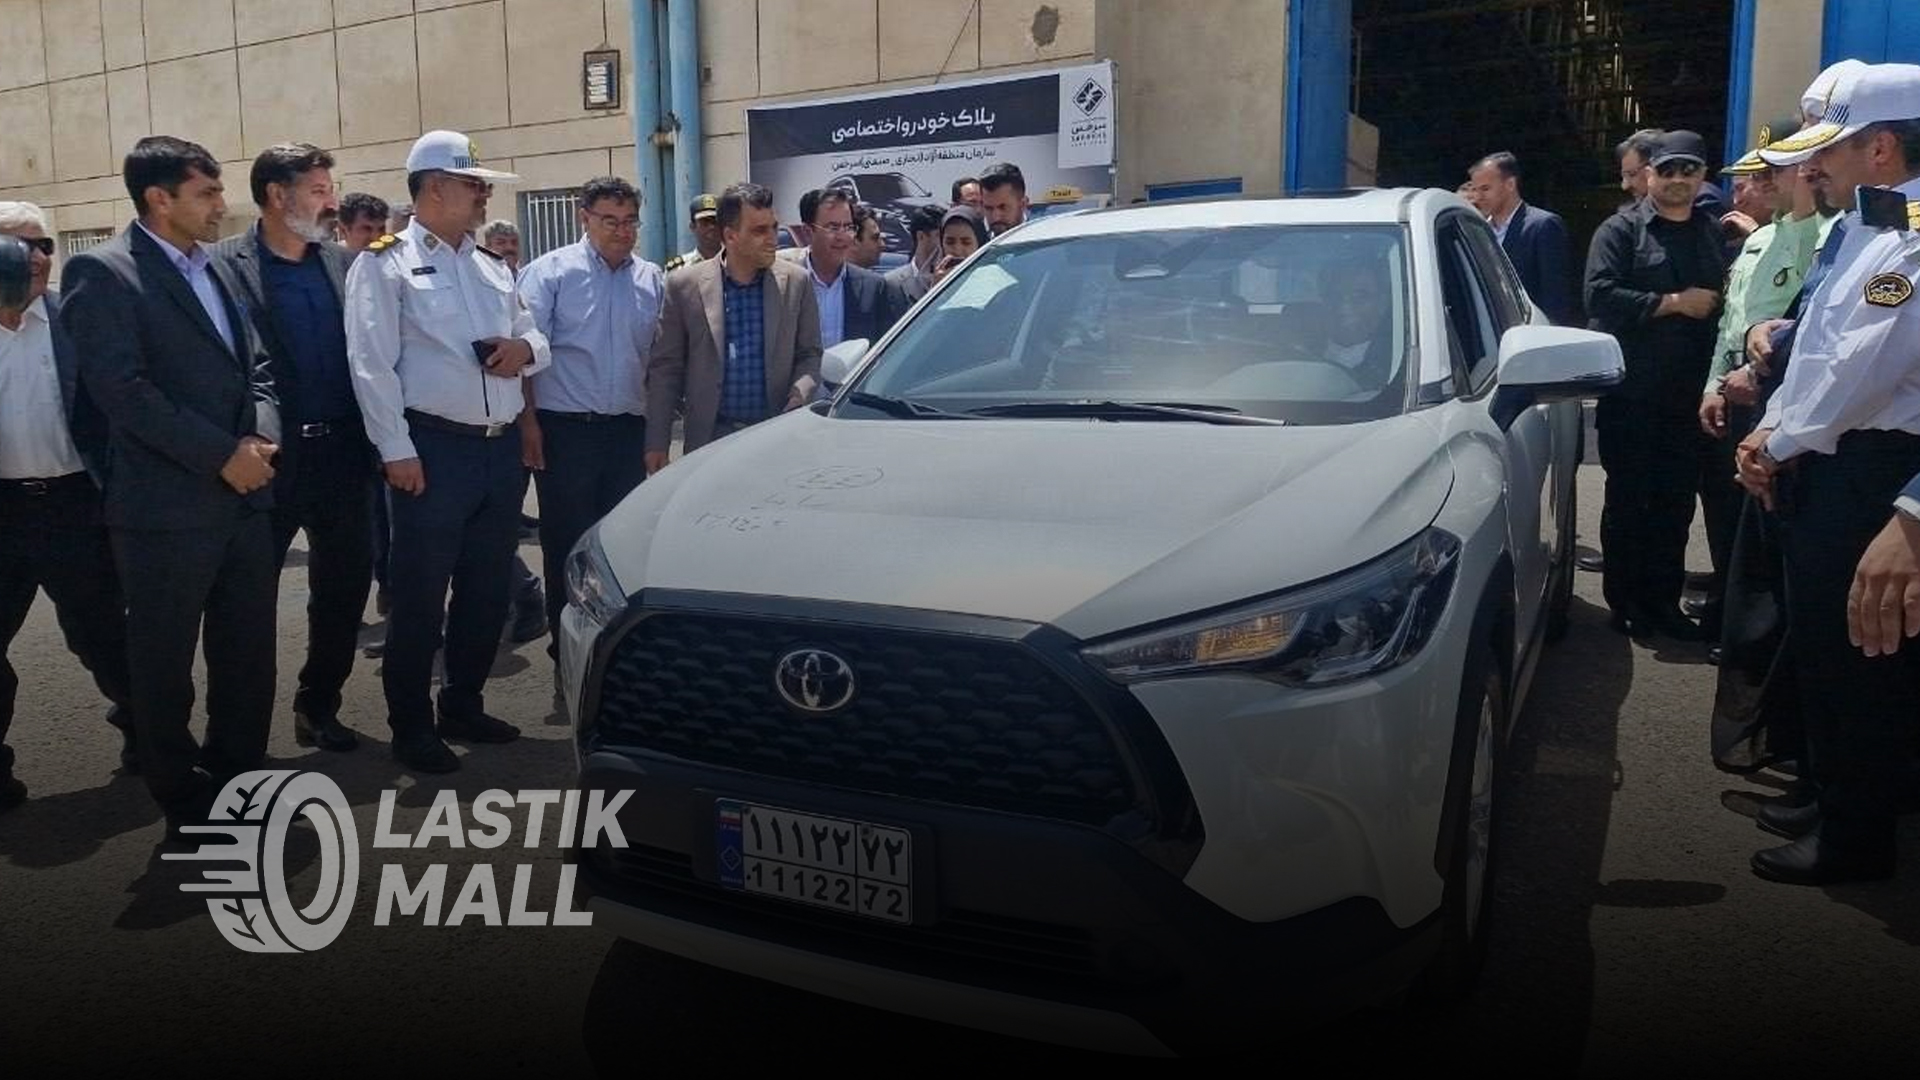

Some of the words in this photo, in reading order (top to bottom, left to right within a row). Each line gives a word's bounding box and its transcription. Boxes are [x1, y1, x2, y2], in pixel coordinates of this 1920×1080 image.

[831, 115, 902, 144] اختصاصی
[901, 111, 950, 138] خودرو
[951, 106, 996, 134] پلاک
[965, 147, 996, 160] سازمان
[750, 813, 851, 866] ۱۱۱۲۲
[861, 834, 904, 876] ۷۲
[751, 861, 851, 906] 11122
[863, 883, 904, 917] 72
